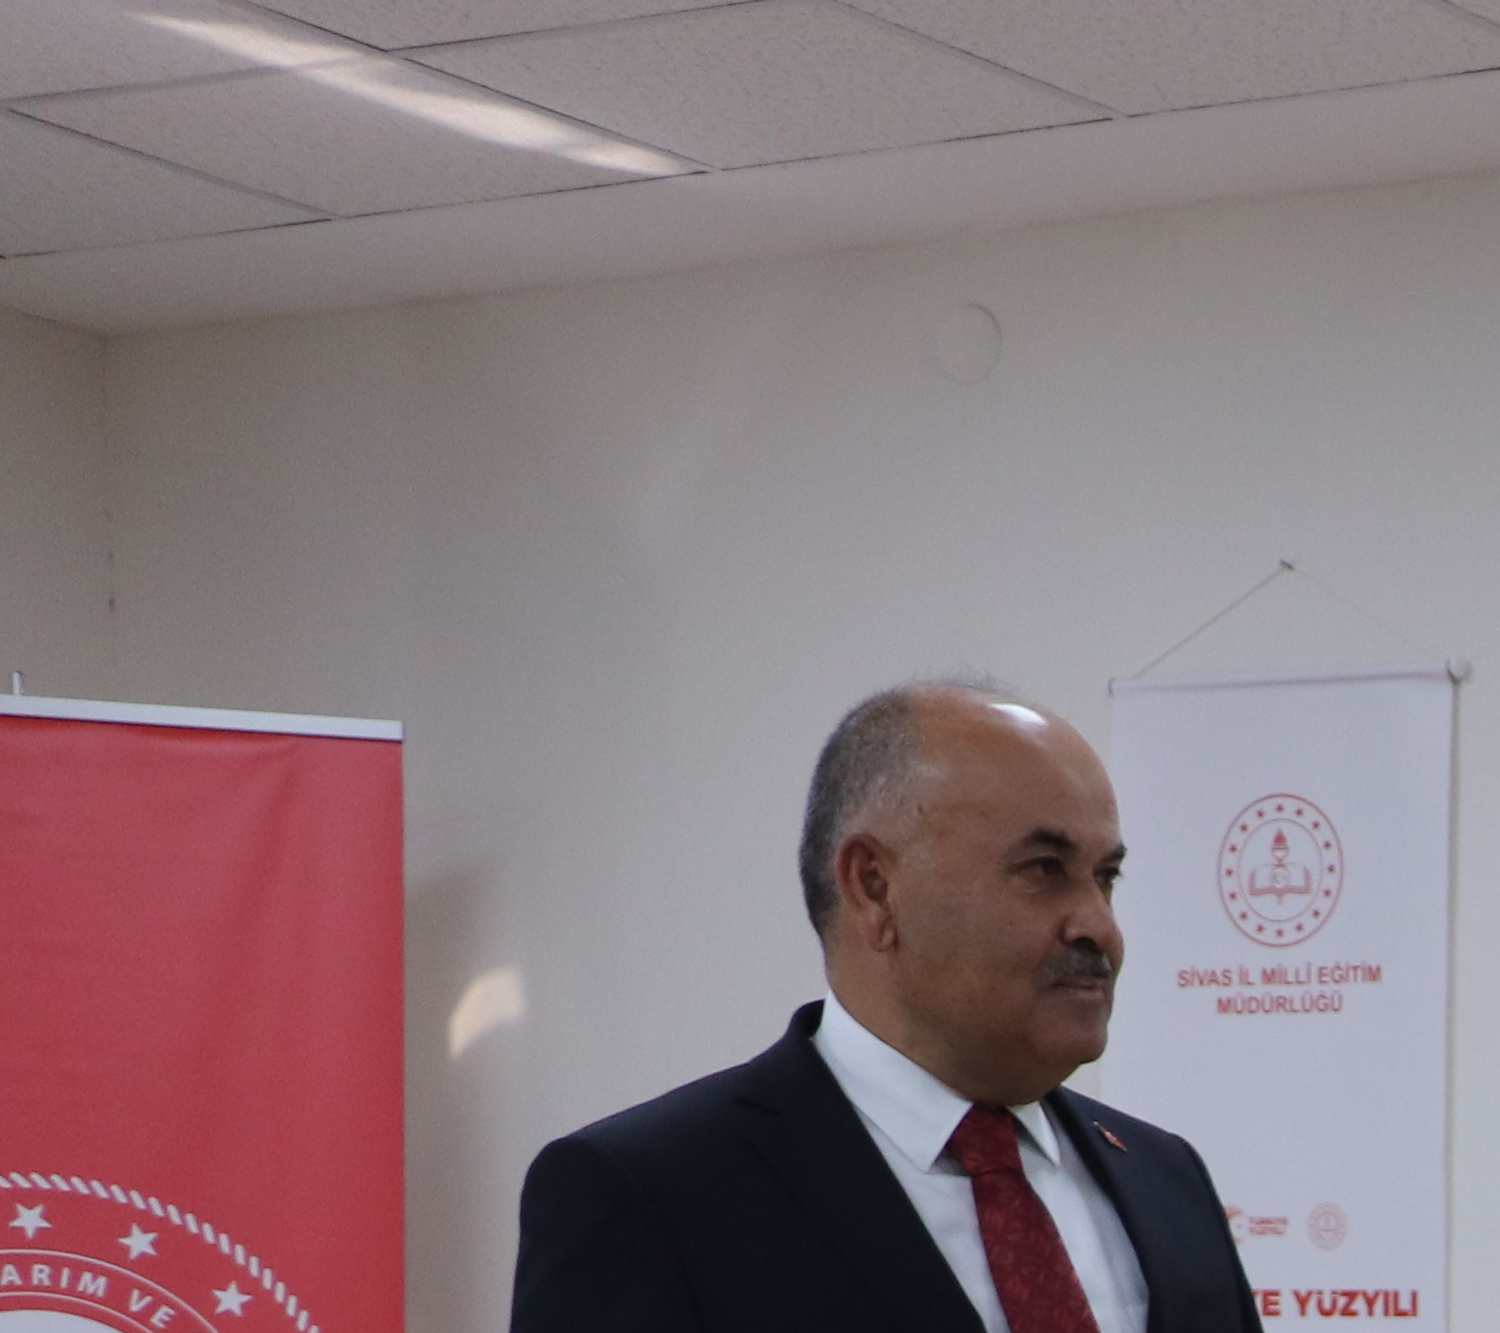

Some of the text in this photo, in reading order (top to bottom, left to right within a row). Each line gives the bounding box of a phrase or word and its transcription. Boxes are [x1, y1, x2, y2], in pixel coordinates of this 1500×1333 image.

[1177, 965, 1232, 988] SİVAS
[1239, 964, 1255, 986] İL
[1317, 959, 1382, 984] EĞİTİM
[1216, 990, 1343, 1014] MÜDÜRLÜĞÜ
[129, 1288, 177, 1329] VE
[1292, 1287, 1418, 1318] YÜZYILI
